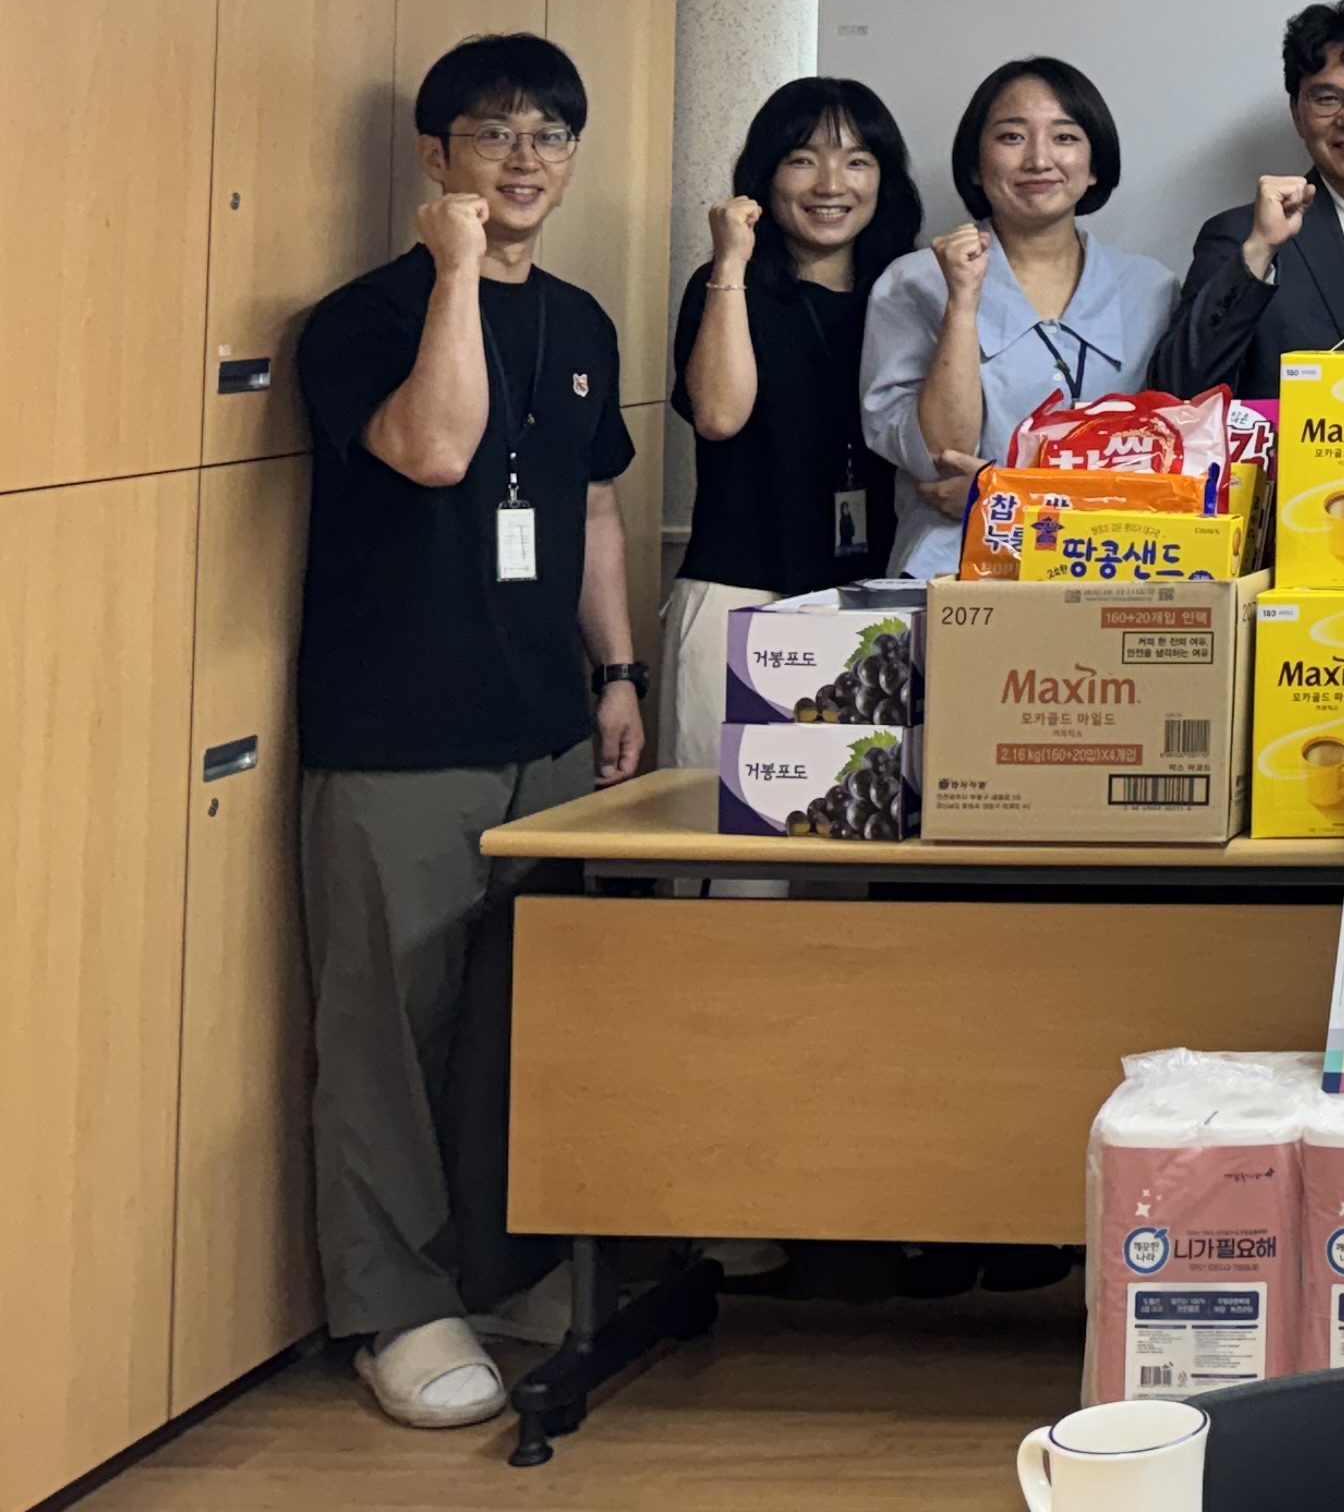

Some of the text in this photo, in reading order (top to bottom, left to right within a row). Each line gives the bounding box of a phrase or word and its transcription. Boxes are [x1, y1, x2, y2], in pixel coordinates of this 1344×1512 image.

[1063, 538, 1184, 579] 땅콩샌드
[941, 607, 994, 625] 2077
[1106, 612, 1175, 624] 160+20개입
[754, 651, 817, 668] 거봉포도
[1001, 663, 1136, 704] Maxim
[1292, 693, 1330, 702] 모카골드
[1022, 712, 1115, 725] 모카골드 마일드
[745, 763, 808, 780] 거봉포도
[1173, 1237, 1277, 1260] 니가필요해
[1136, 1253, 1155, 1263] 나라
